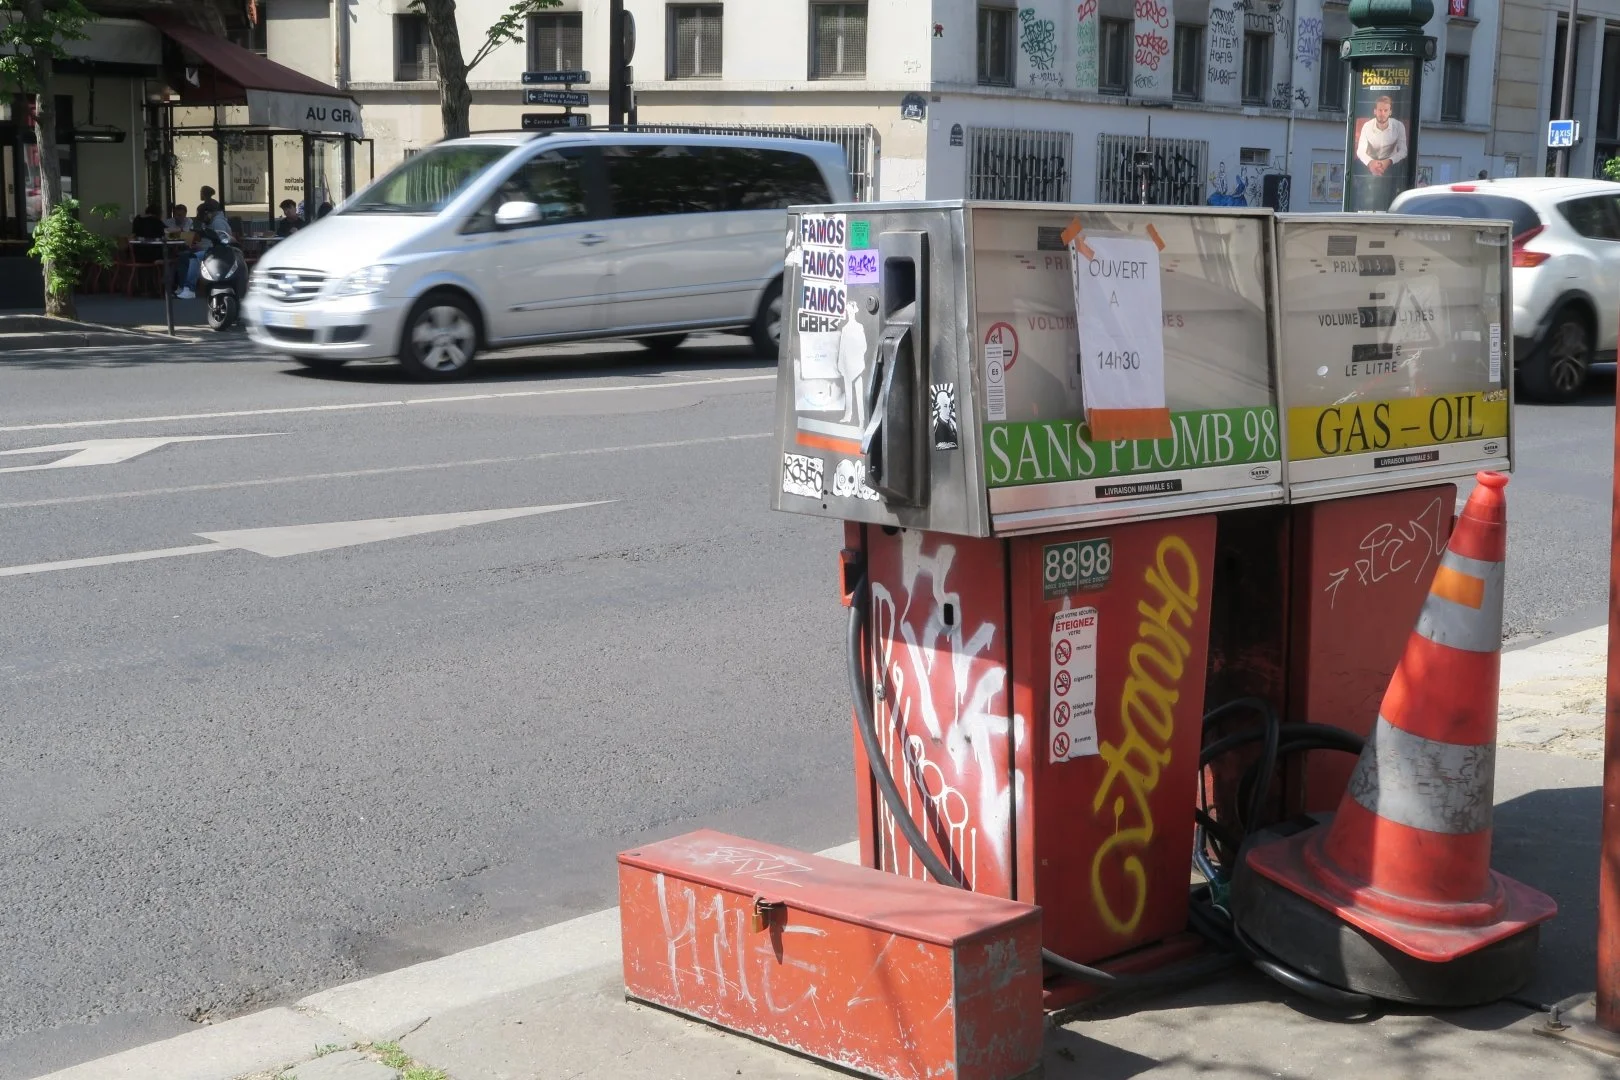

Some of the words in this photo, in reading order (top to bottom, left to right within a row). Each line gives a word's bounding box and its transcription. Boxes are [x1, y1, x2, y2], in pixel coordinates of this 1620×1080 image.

[1362, 68, 1410, 77] MATTHIEU
[1362, 77, 1410, 86] LONGATTE
[306, 106, 326, 121] AU
[1551, 129, 1571, 138] TAXIS
[1044, 256, 1072, 271] PRI
[1088, 258, 1148, 280] OUVERT
[1333, 260, 1358, 273] PRIX
[1027, 313, 1077, 331] VOLUM
[1318, 312, 1359, 327] VOLUME
[1399, 308, 1434, 322] LITRES
[1097, 350, 1141, 370] 14h30
[991, 368, 999, 376] E5
[1345, 364, 1358, 377] LE
[1365, 361, 1398, 375] LITRE
[1315, 402, 1392, 456] GAS
[1429, 395, 1485, 442] OIL
[988, 420, 1097, 484] SANS
[1109, 411, 1235, 474] PLOMB
[1244, 408, 1278, 460] 98
[1380, 457, 1405, 466] LIVRAISON
[1405, 454, 1427, 463] MINIMALE
[1104, 485, 1137, 496] LIVRAISON
[1137, 482, 1165, 493] MINIMALE
[1045, 548, 1077, 582] 88
[1079, 542, 1111, 577] 98
[1055, 616, 1094, 632] ÉTEIGNEZ
[1073, 708, 1092, 718] portable
